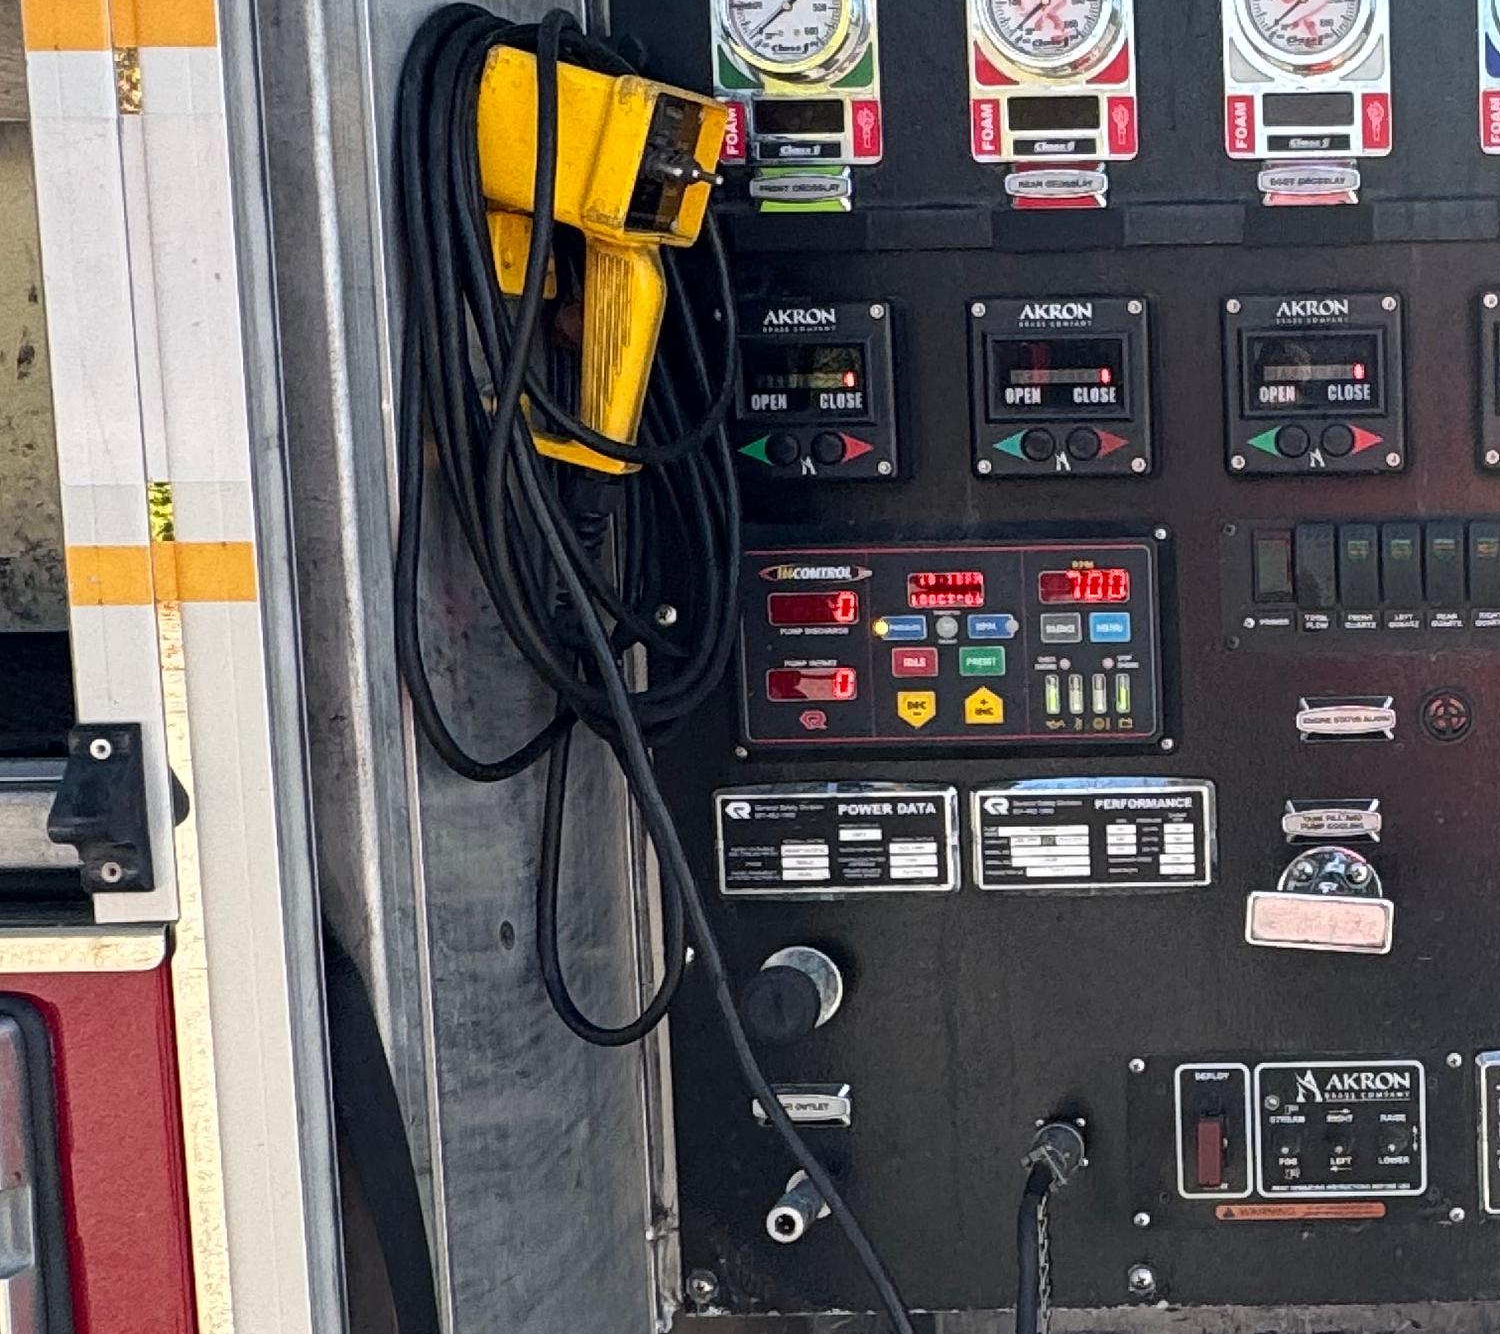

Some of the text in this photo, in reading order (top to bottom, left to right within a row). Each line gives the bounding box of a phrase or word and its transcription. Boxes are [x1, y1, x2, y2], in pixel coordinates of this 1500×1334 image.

[725, 107, 738, 154] FOAM
[981, 104, 994, 151] FOAM
[1235, 102, 1248, 149] FOAM
[1019, 303, 1092, 320] AKRON
[1276, 299, 1349, 316] AKRON
[763, 308, 836, 325] AKRON
[820, 392, 862, 409] CLOSE
[1005, 387, 1041, 404] OPEN
[1074, 386, 1116, 403] CLOSE
[1259, 386, 1296, 403] OPEN
[1328, 384, 1371, 401] CLOSE
[751, 393, 787, 410] OPEN
[779, 566, 851, 580] INCONTROL
[1066, 569, 1127, 599] 700
[903, 657, 927, 667] IDLE
[832, 668, 855, 699] 0
[838, 802, 936, 815] POWER DATA
[1095, 797, 1192, 809] PERFORMANCE
[1325, 1072, 1410, 1090] AKRON
[1278, 1157, 1298, 1166] FOG
[1330, 1156, 1352, 1165] LEFT
